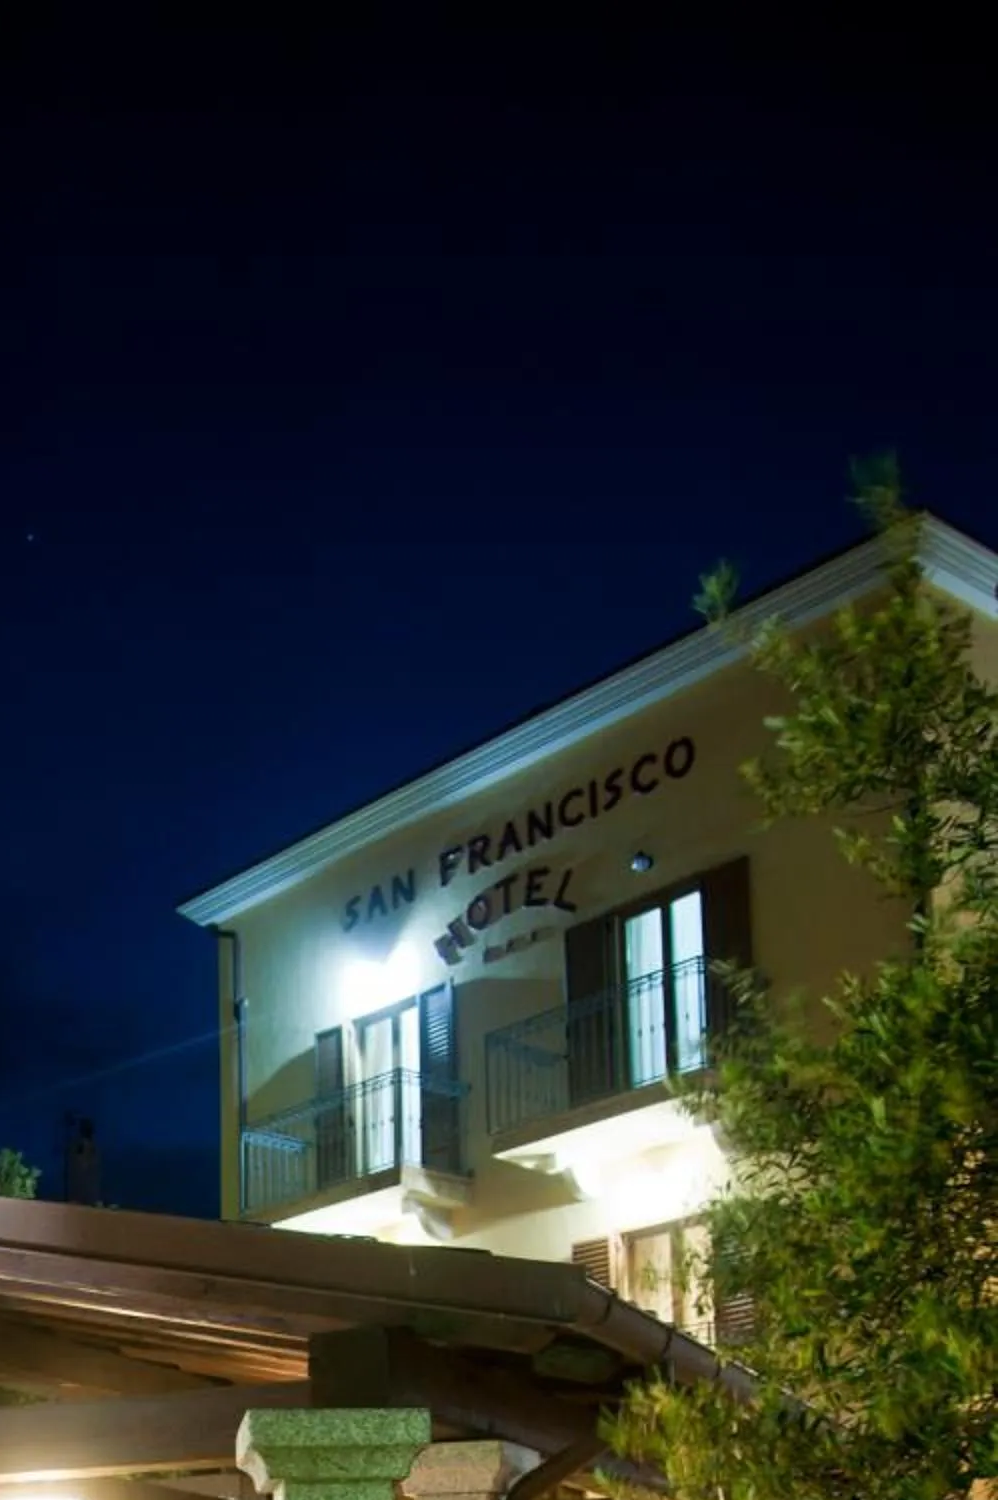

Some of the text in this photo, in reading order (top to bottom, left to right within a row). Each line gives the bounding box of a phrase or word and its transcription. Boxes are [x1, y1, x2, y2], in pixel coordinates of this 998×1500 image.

[339, 735, 696, 933] SAN FRANCISCO
[433, 866, 578, 966] HOTEL
